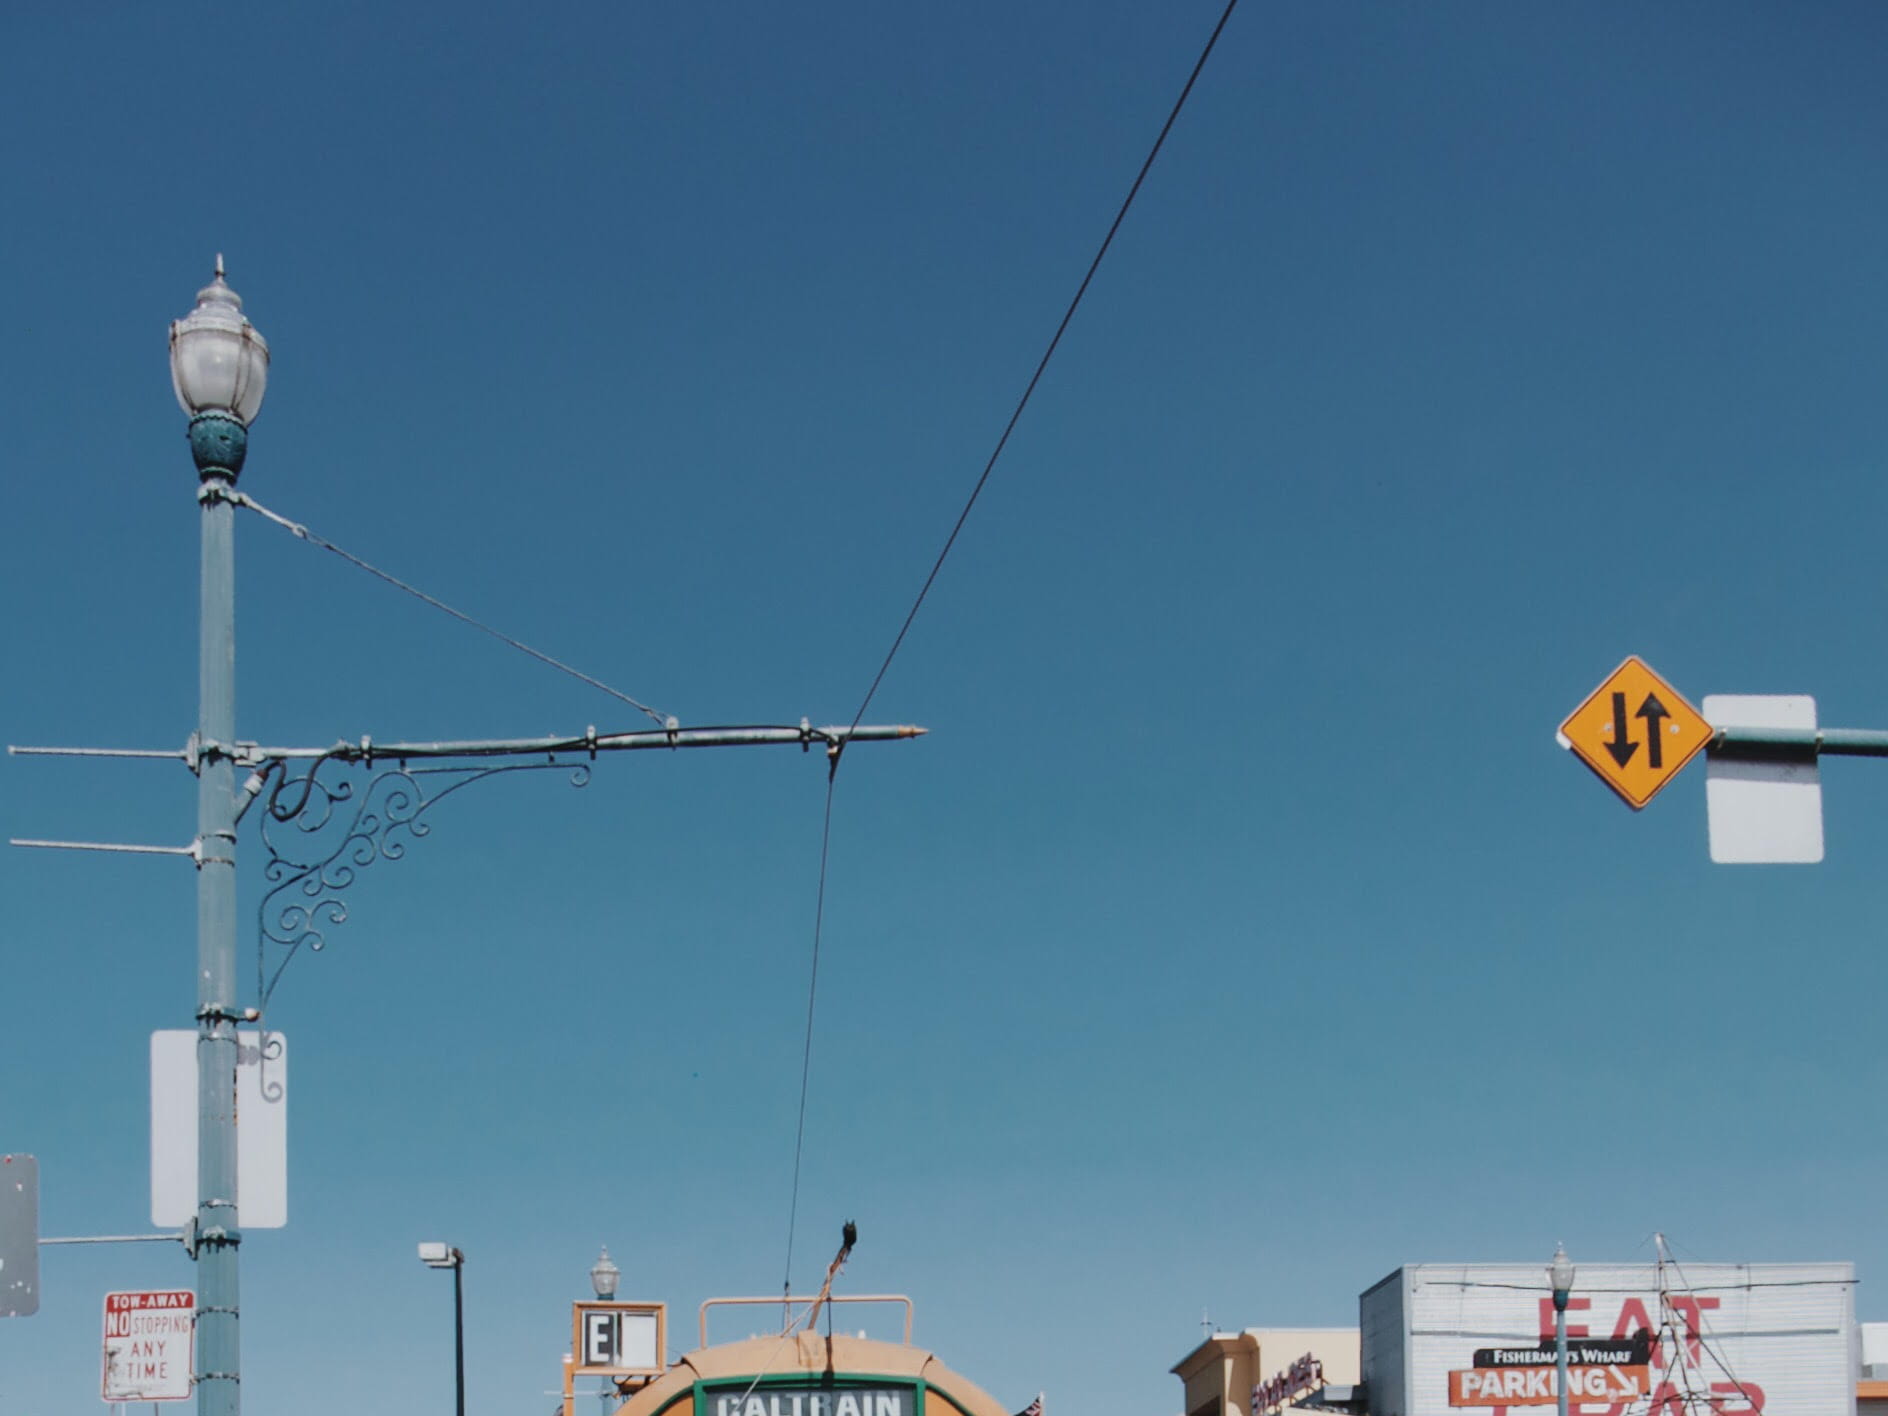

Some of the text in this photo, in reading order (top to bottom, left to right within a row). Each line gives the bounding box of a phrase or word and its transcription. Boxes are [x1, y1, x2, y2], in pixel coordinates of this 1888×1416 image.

[111, 1294, 189, 1309] TOW-AWAY
[107, 1311, 189, 1336] NO STOPPING
[1539, 1297, 1721, 1370] EAT
[131, 1341, 166, 1357] ANY
[590, 1315, 610, 1362] E
[127, 1361, 168, 1379] TIME
[1461, 1368, 1607, 1399] PARKING
